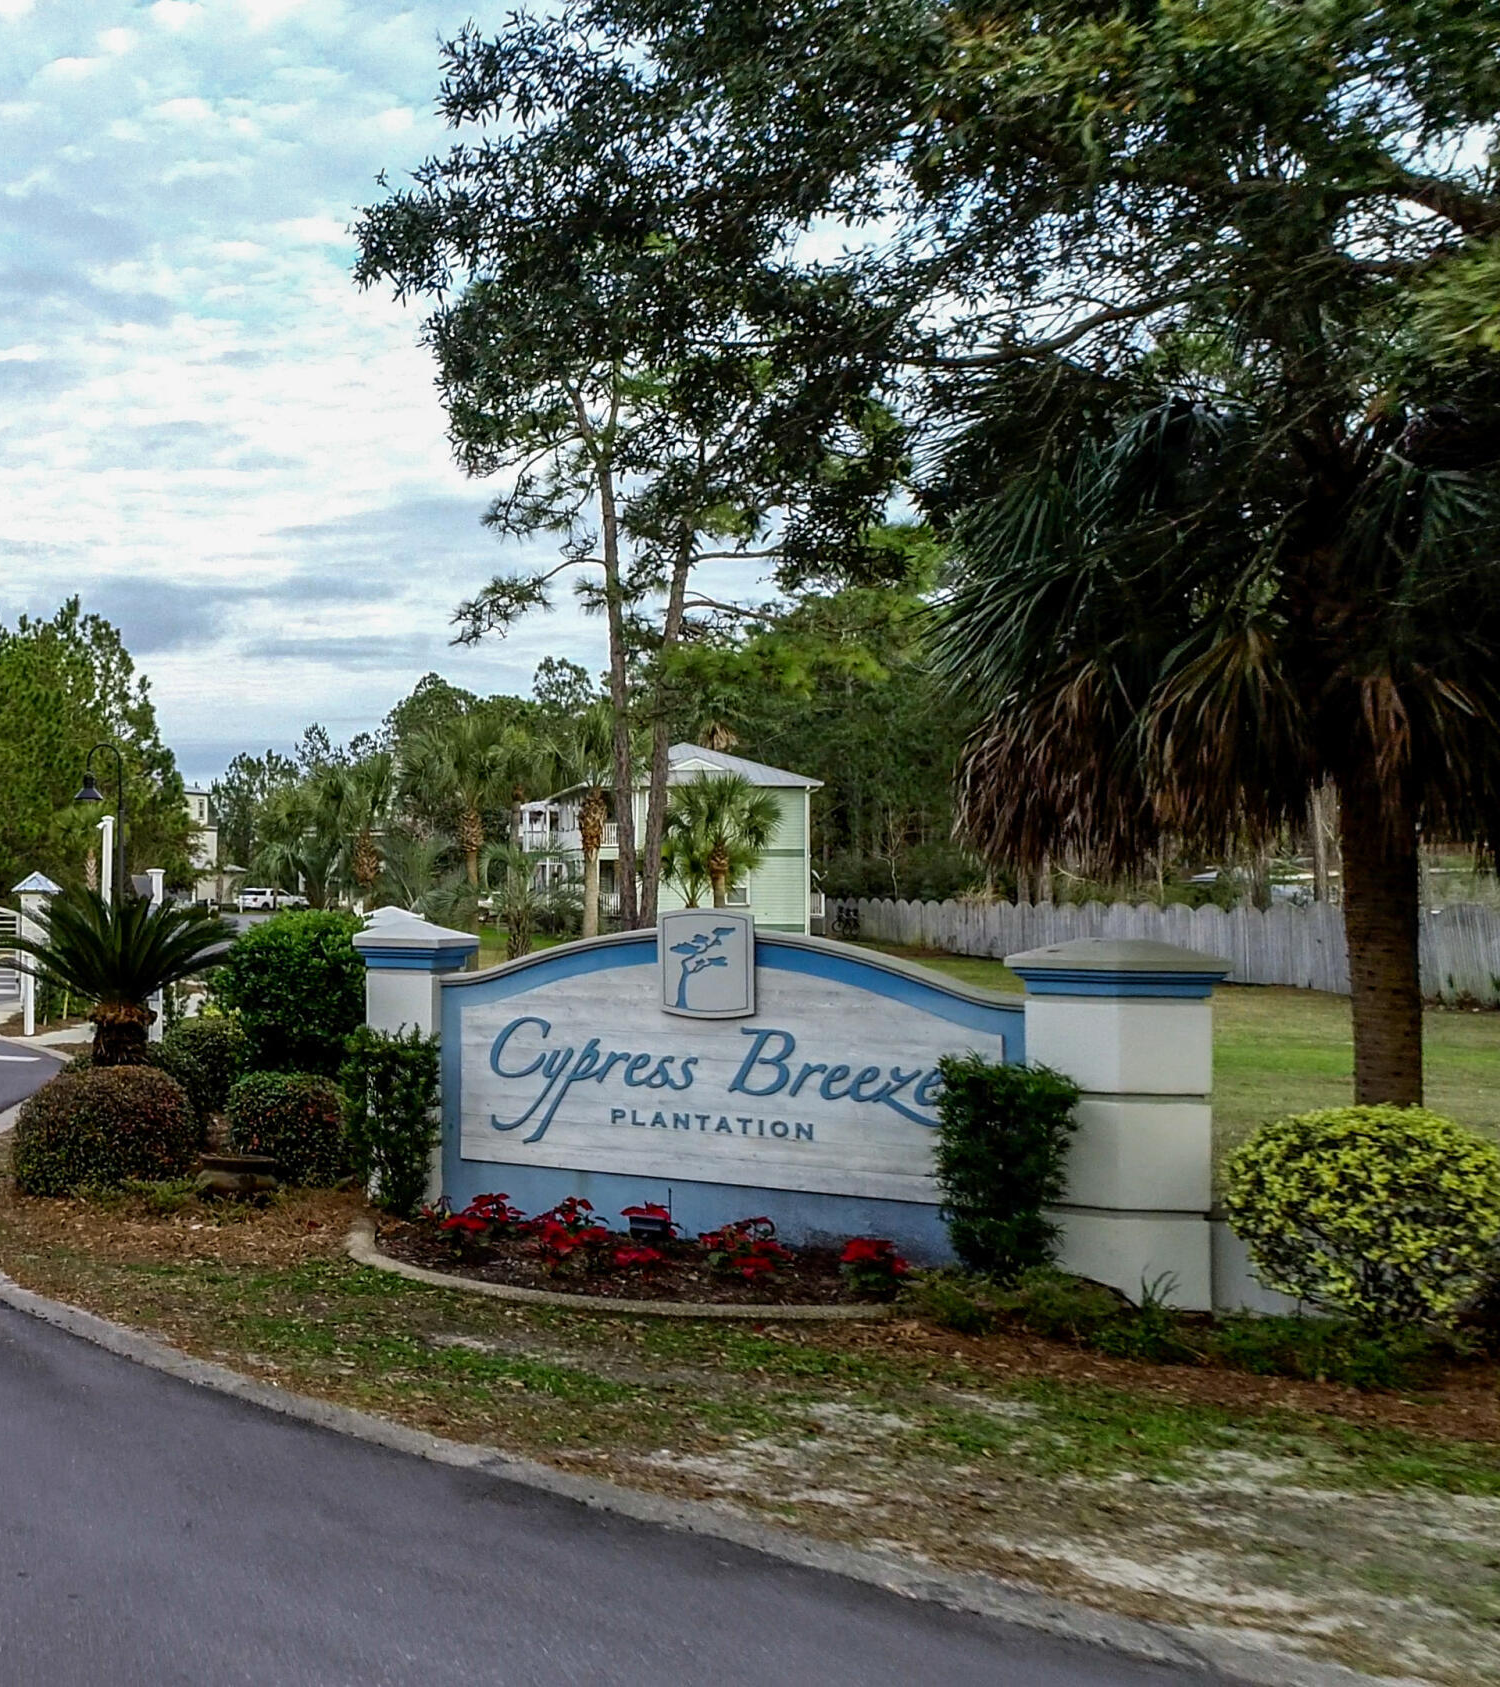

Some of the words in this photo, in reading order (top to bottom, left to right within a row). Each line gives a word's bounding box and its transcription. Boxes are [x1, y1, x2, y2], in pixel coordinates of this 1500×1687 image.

[490, 1016, 699, 1144] Cypress
[728, 1027, 943, 1127] Breeze
[610, 1107, 814, 1140] PLANTATION
